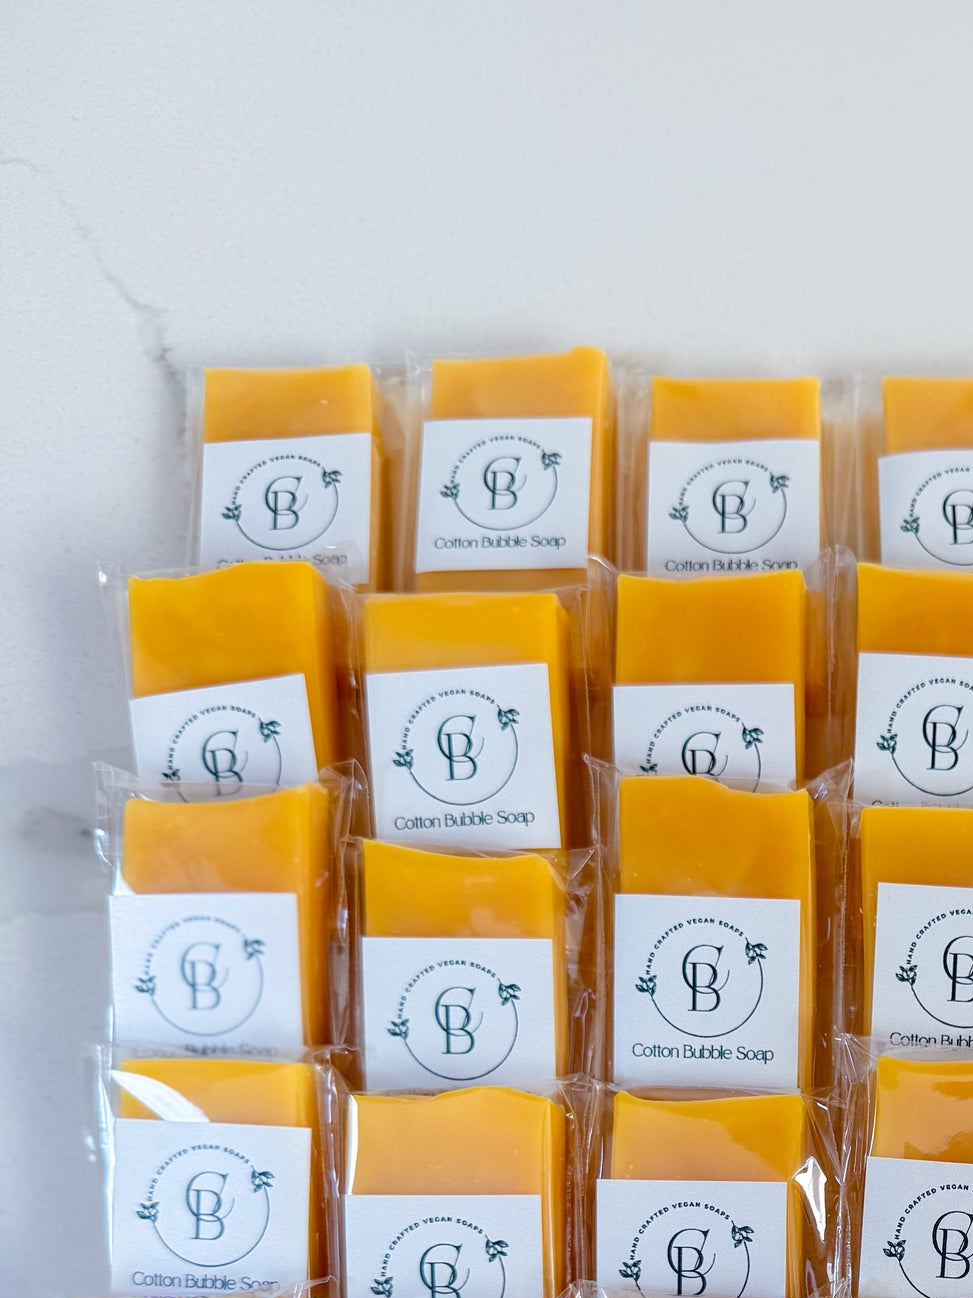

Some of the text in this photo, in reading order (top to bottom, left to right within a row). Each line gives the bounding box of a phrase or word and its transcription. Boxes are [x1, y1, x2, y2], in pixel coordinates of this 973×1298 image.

[434, 534, 566, 549] Cotton Bubble Soap
[666, 559, 710, 572] Cotton
[713, 557, 759, 570] Bubble
[886, 710, 897, 736] HAND
[895, 681, 926, 709] CRAFTED
[928, 677, 957, 685] VEGAN
[394, 810, 535, 830] Cotton Bubble Soap
[645, 917, 744, 977] HAND CRAFTED VEGAN SOAPS
[906, 941, 917, 967] HAND
[915, 912, 947, 940] CRAFTED
[631, 1042, 775, 1065] Cotton Bubble Soap
[629, 1201, 731, 1262] HAND CRAFTED VEGAN SOAPS
[894, 1215, 906, 1242] HAND
[904, 1187, 937, 1215] CRAFTED
[939, 1183, 970, 1191] VEGAN
[132, 1270, 181, 1287] Cotton
[184, 1273, 236, 1290] Bubble
